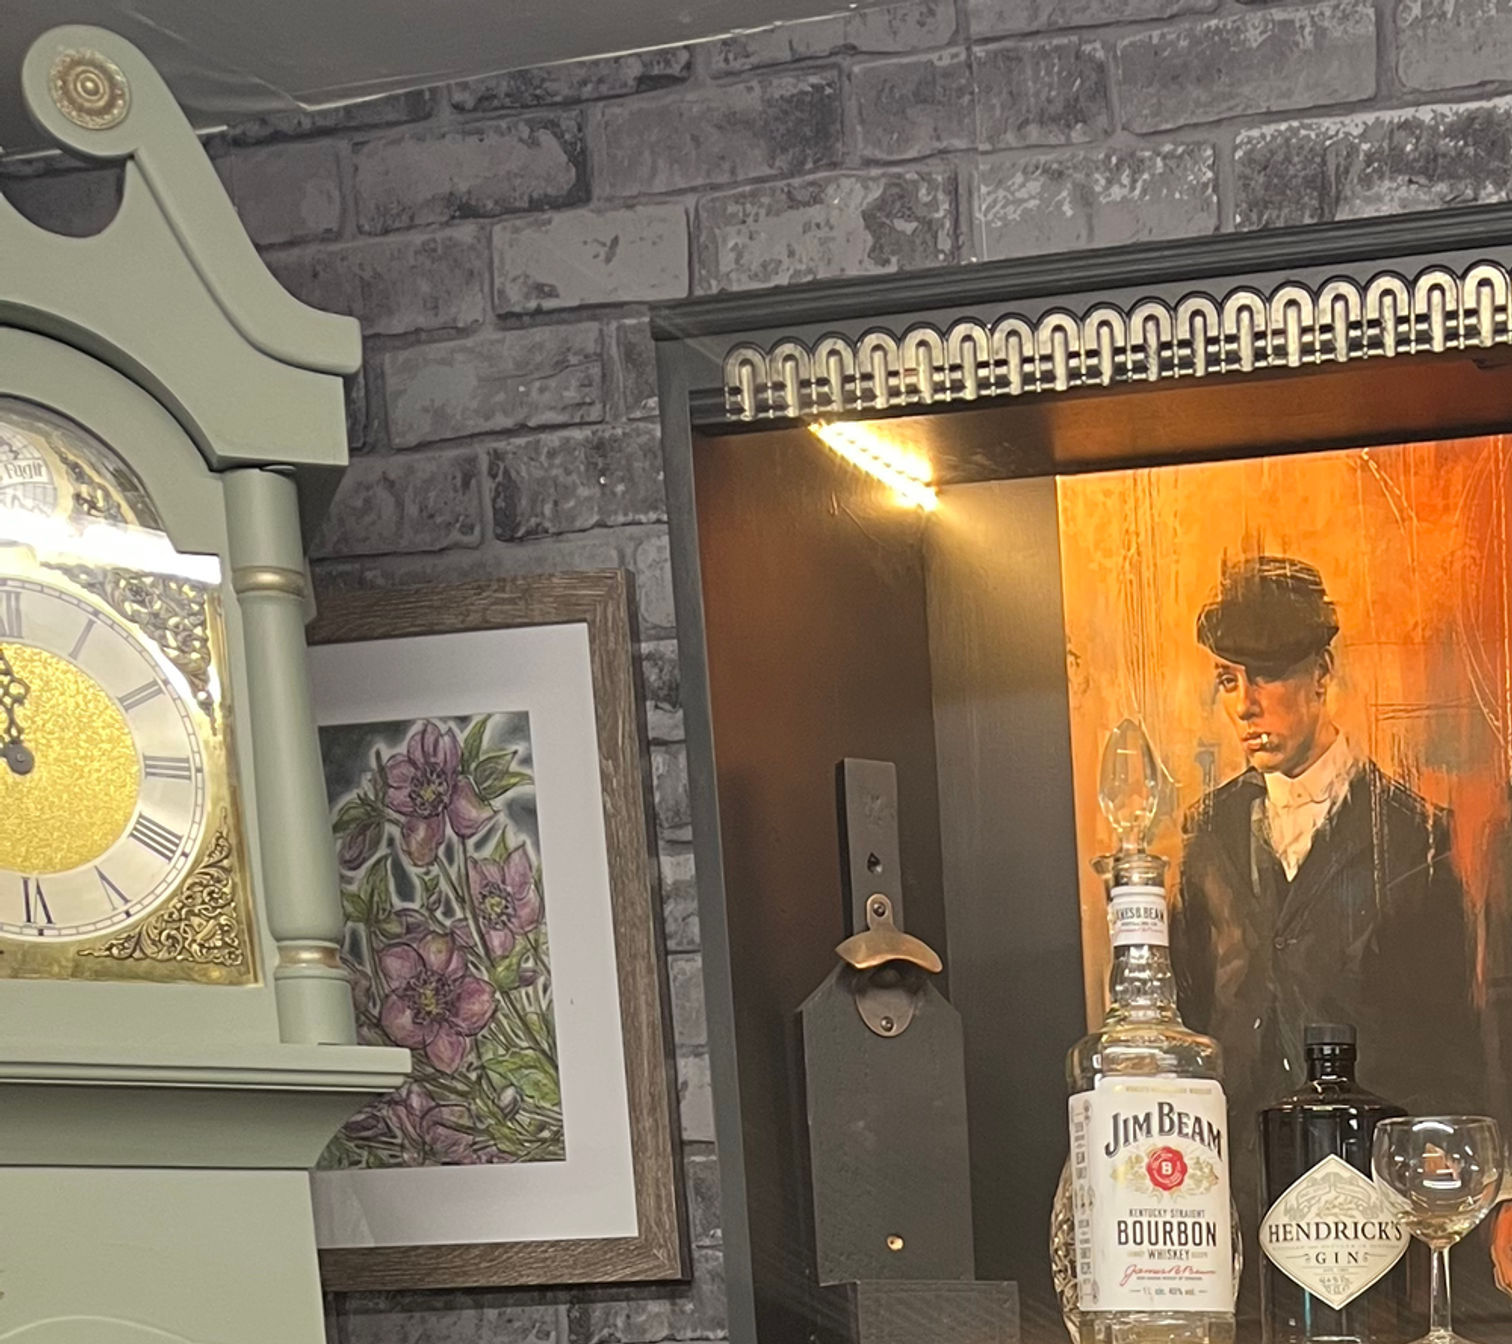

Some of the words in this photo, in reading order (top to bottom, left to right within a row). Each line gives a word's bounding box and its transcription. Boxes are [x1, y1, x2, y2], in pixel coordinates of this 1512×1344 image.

[4, 462, 43, 480] Fugit
[1105, 1112, 1153, 1158] JIM
[1157, 1102, 1222, 1161] BEAM
[1161, 1162, 1173, 1175] B
[1129, 1208, 1167, 1218] KENTUCKY
[1117, 1220, 1217, 1247] BOURBON
[1268, 1221, 1403, 1243] HENDRICK'S
[1148, 1249, 1190, 1260] WHISKEY
[1315, 1251, 1359, 1264] GIN
